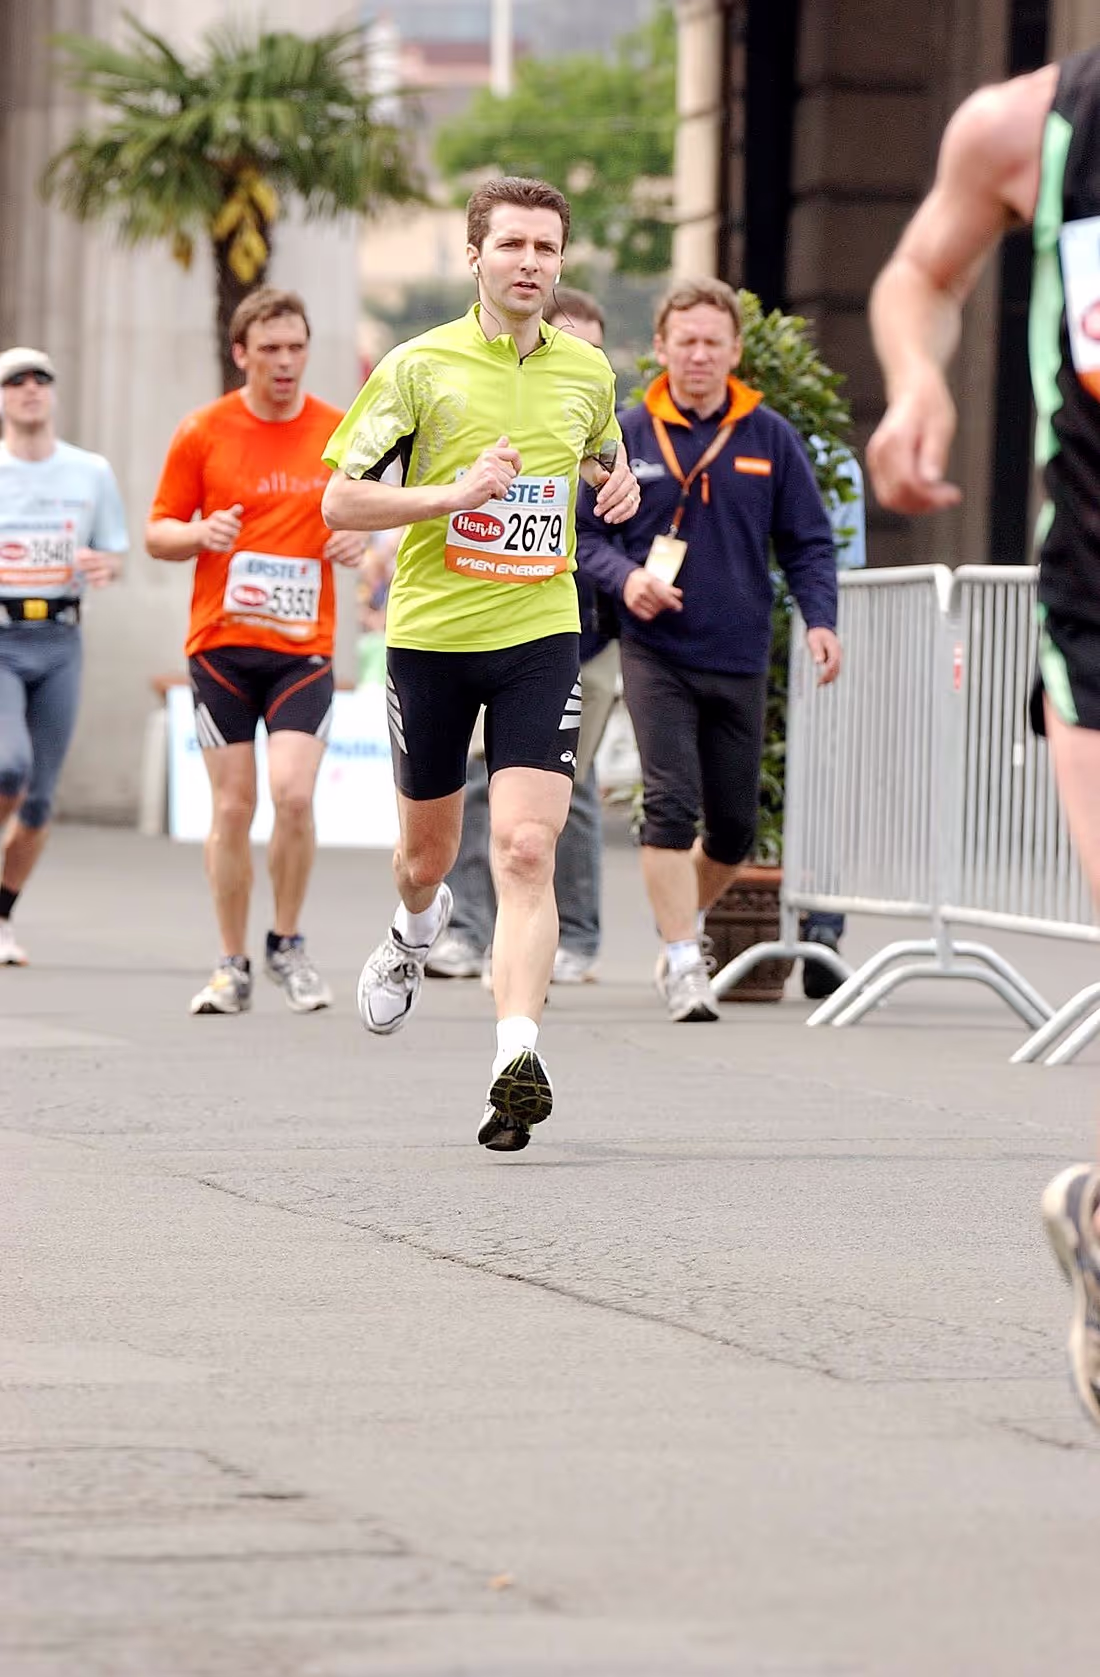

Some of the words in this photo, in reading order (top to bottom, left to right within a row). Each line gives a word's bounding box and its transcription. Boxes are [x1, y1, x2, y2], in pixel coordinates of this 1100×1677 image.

[502, 484, 540, 504] STE
[457, 515, 501, 536] Hervis
[504, 513, 562, 552] 2679
[457, 557, 496, 572] WIEN
[496, 564, 556, 576] ENERGIE
